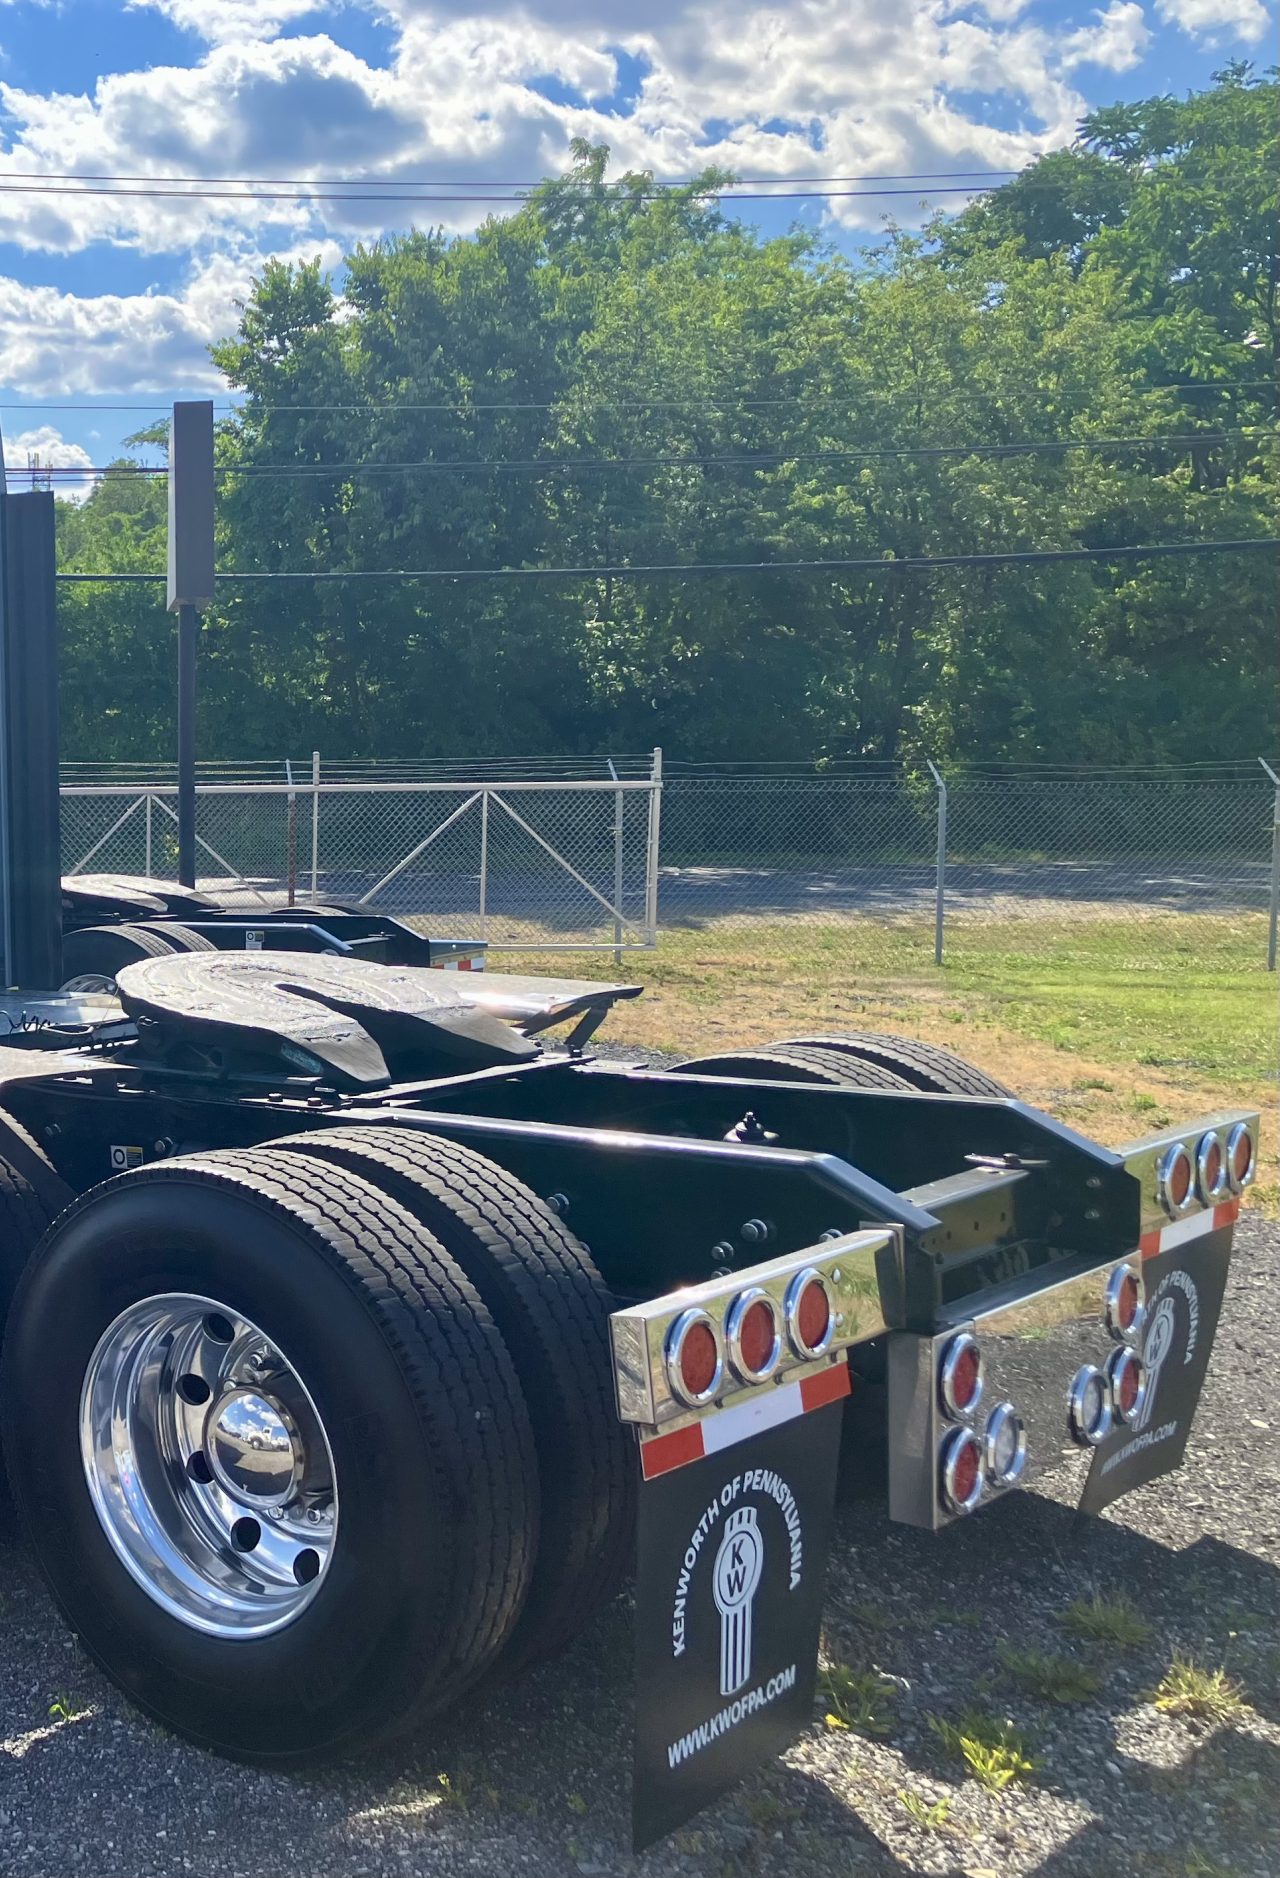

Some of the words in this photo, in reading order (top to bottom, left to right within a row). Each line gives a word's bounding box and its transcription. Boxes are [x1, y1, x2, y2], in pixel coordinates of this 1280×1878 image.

[1169, 1270, 1199, 1366] PENNSYLVANIA
[672, 1498, 720, 1657] KENWORTH
[720, 1475, 741, 1507] OF
[743, 1468, 802, 1591] PENNSYLVANIA
[667, 1664, 796, 1769] WWW.KWOFPA.COM
